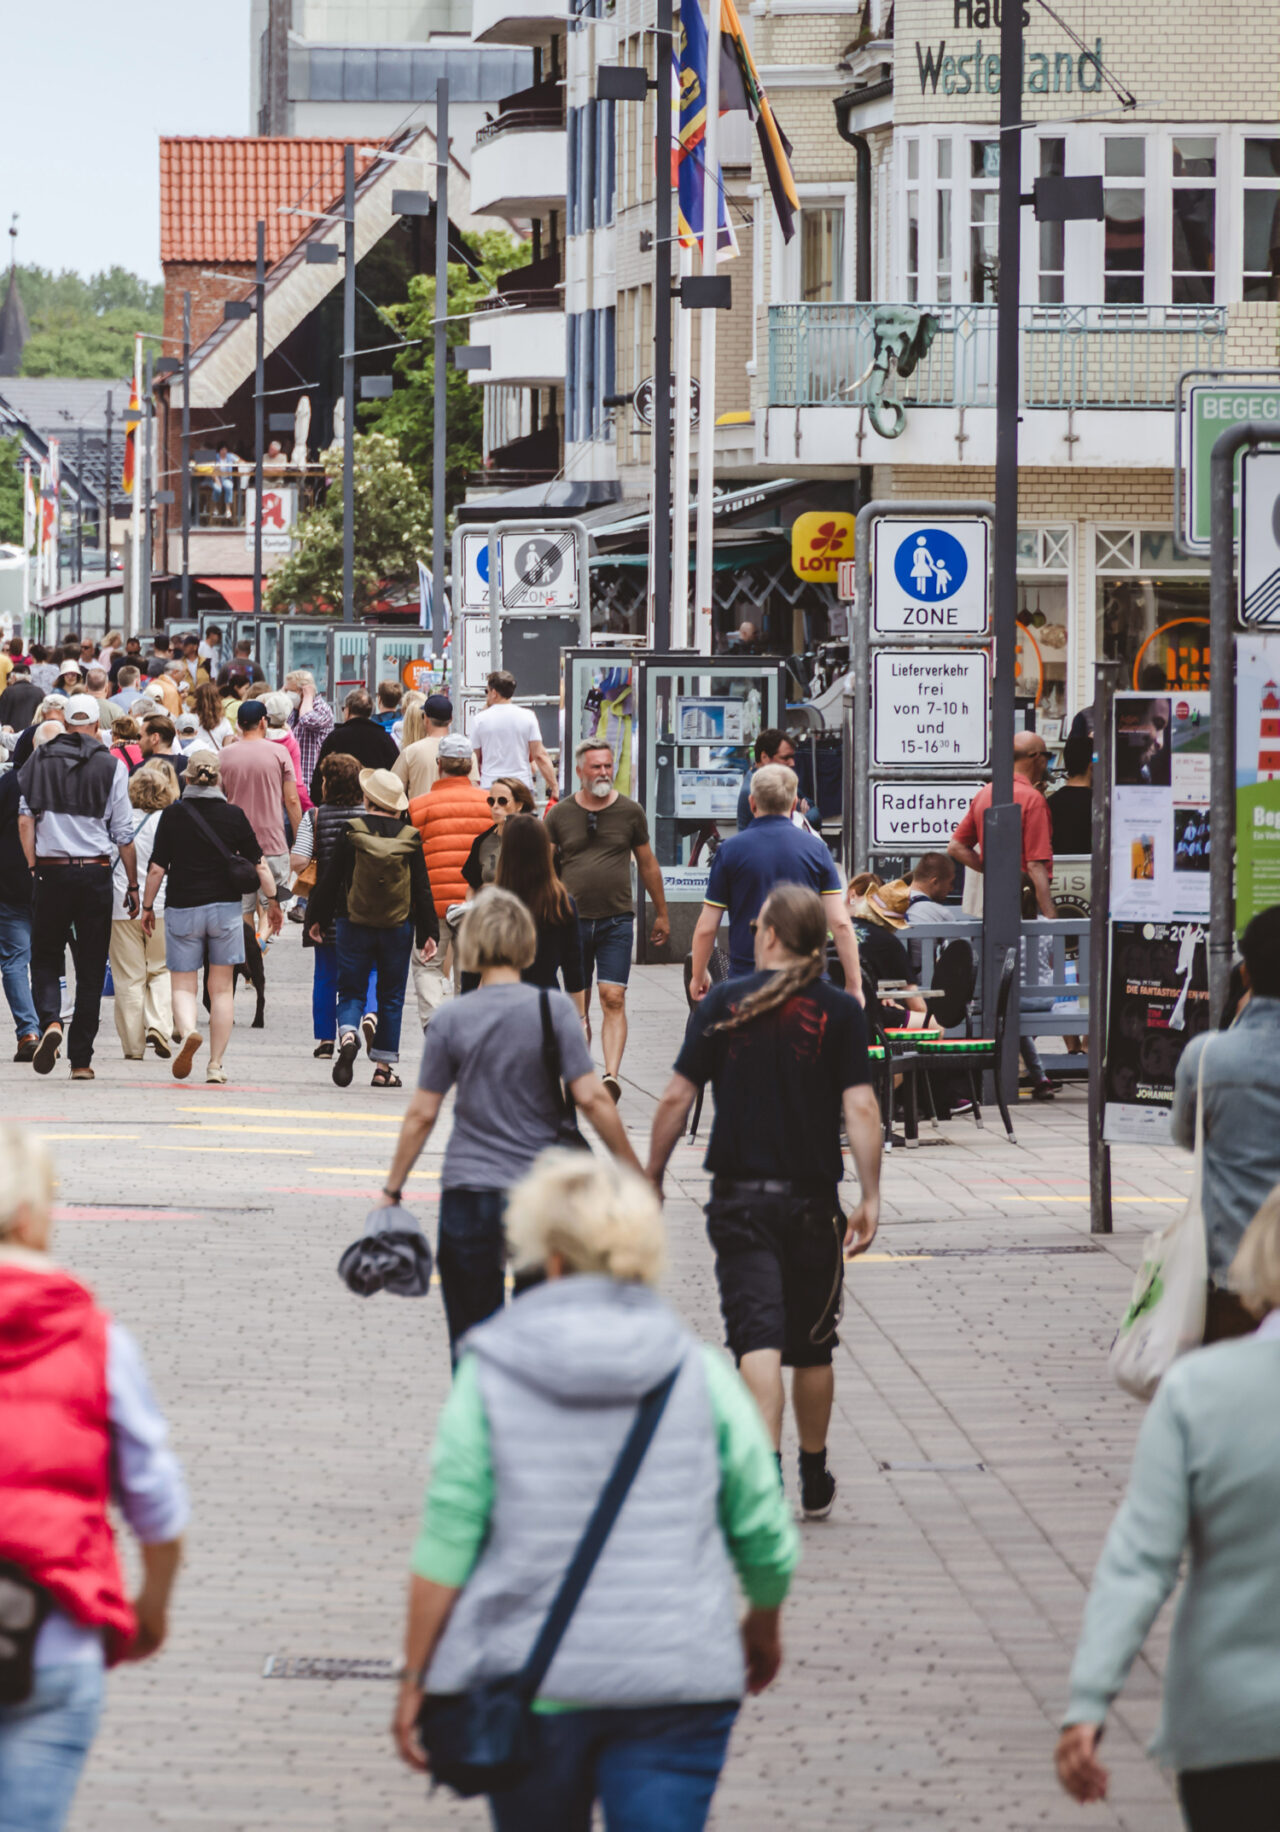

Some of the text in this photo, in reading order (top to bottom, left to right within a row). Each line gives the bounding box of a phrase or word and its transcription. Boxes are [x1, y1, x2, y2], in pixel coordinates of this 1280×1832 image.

[915, 37, 1102, 96] Westeland
[1202, 396, 1280, 420] BEGEG
[902, 607, 959, 625] ZONE
[891, 663, 969, 677] Lieferverkehr
[918, 682, 944, 696] frei
[893, 701, 969, 715] von 7-10 h
[916, 720, 945, 734] und
[953, 740, 961, 753] h
[1050, 875, 1087, 892] EIS
[1054, 895, 1091, 916] BISTR
[1140, 986, 1197, 999] FANTASTISCEN
